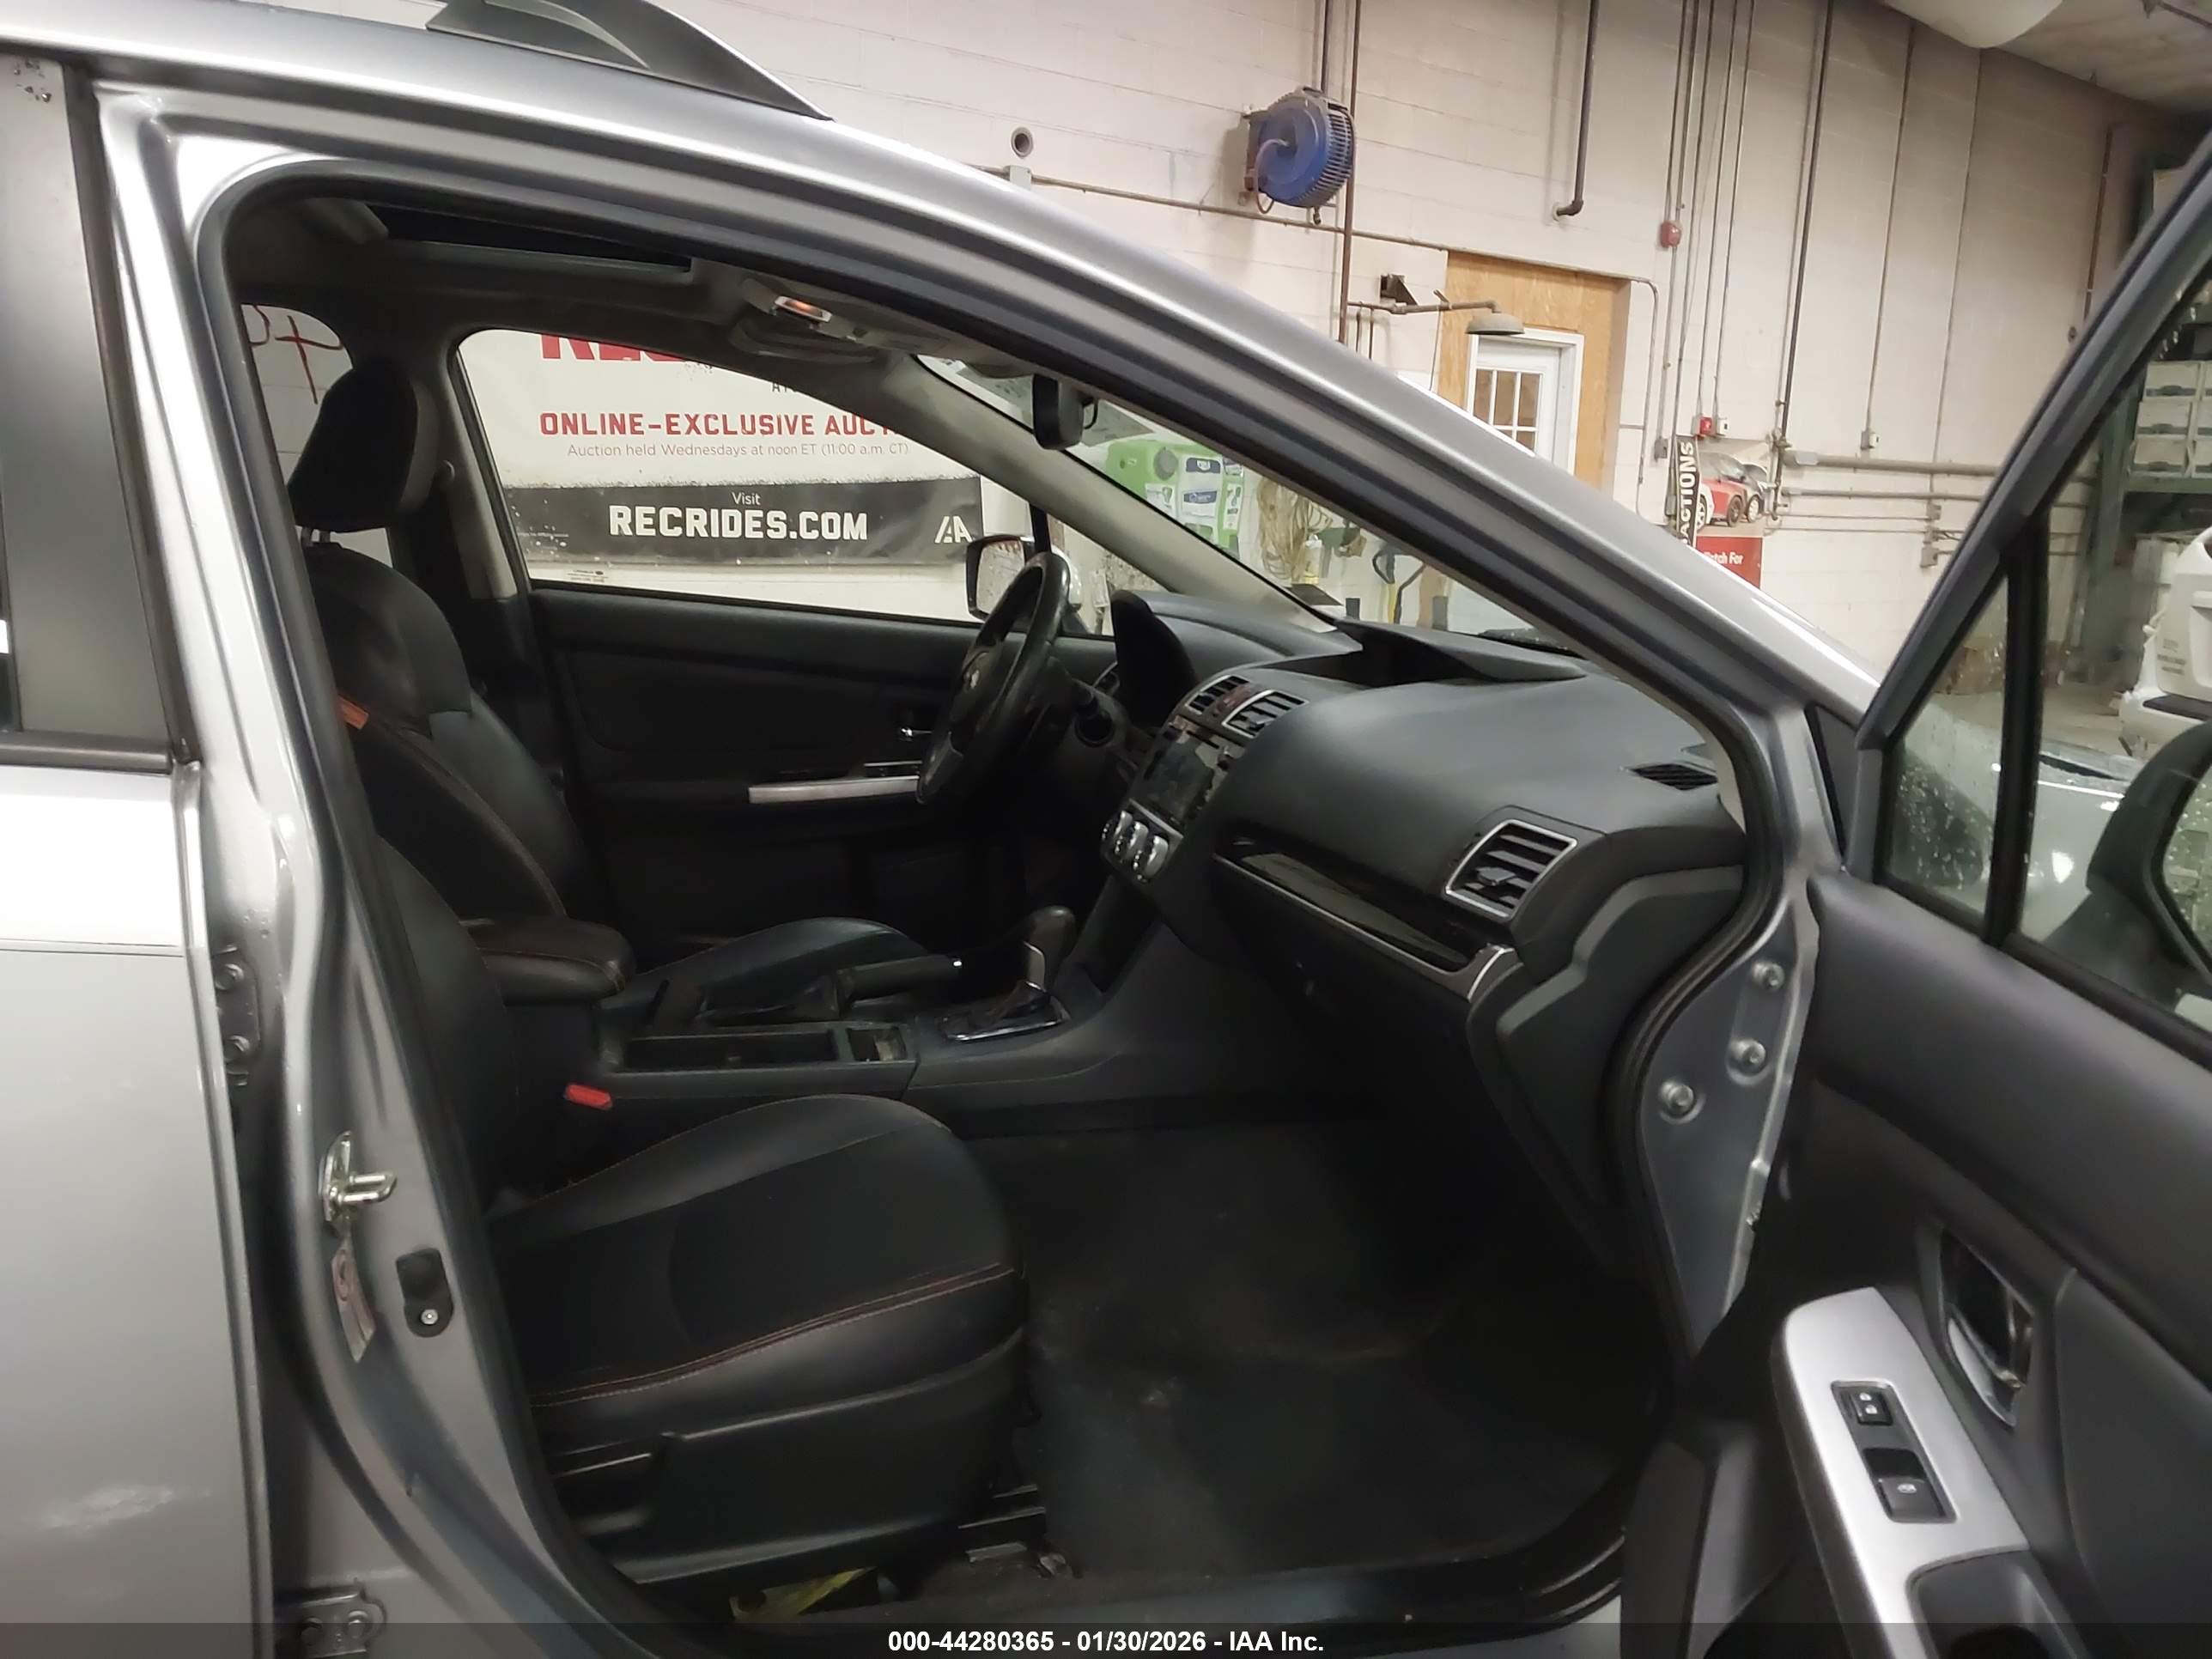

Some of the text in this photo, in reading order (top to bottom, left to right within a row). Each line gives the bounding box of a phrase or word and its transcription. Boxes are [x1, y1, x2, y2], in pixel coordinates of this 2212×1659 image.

[540, 412, 815, 435] ONLINE-EXCLUSIVE
[567, 444, 622, 457] Auction
[626, 443, 656, 457] held
[660, 443, 747, 458] Wednesdays
[751, 445, 763, 455] at
[768, 446, 798, 455] noon
[801, 443, 817, 455] ET
[889, 442, 909, 455] CT)
[732, 491, 761, 506] Visit
[1680, 441, 1697, 544] ACTIONS
[609, 505, 868, 540] RECRIDES.COM
[1729, 551, 1744, 564] For
